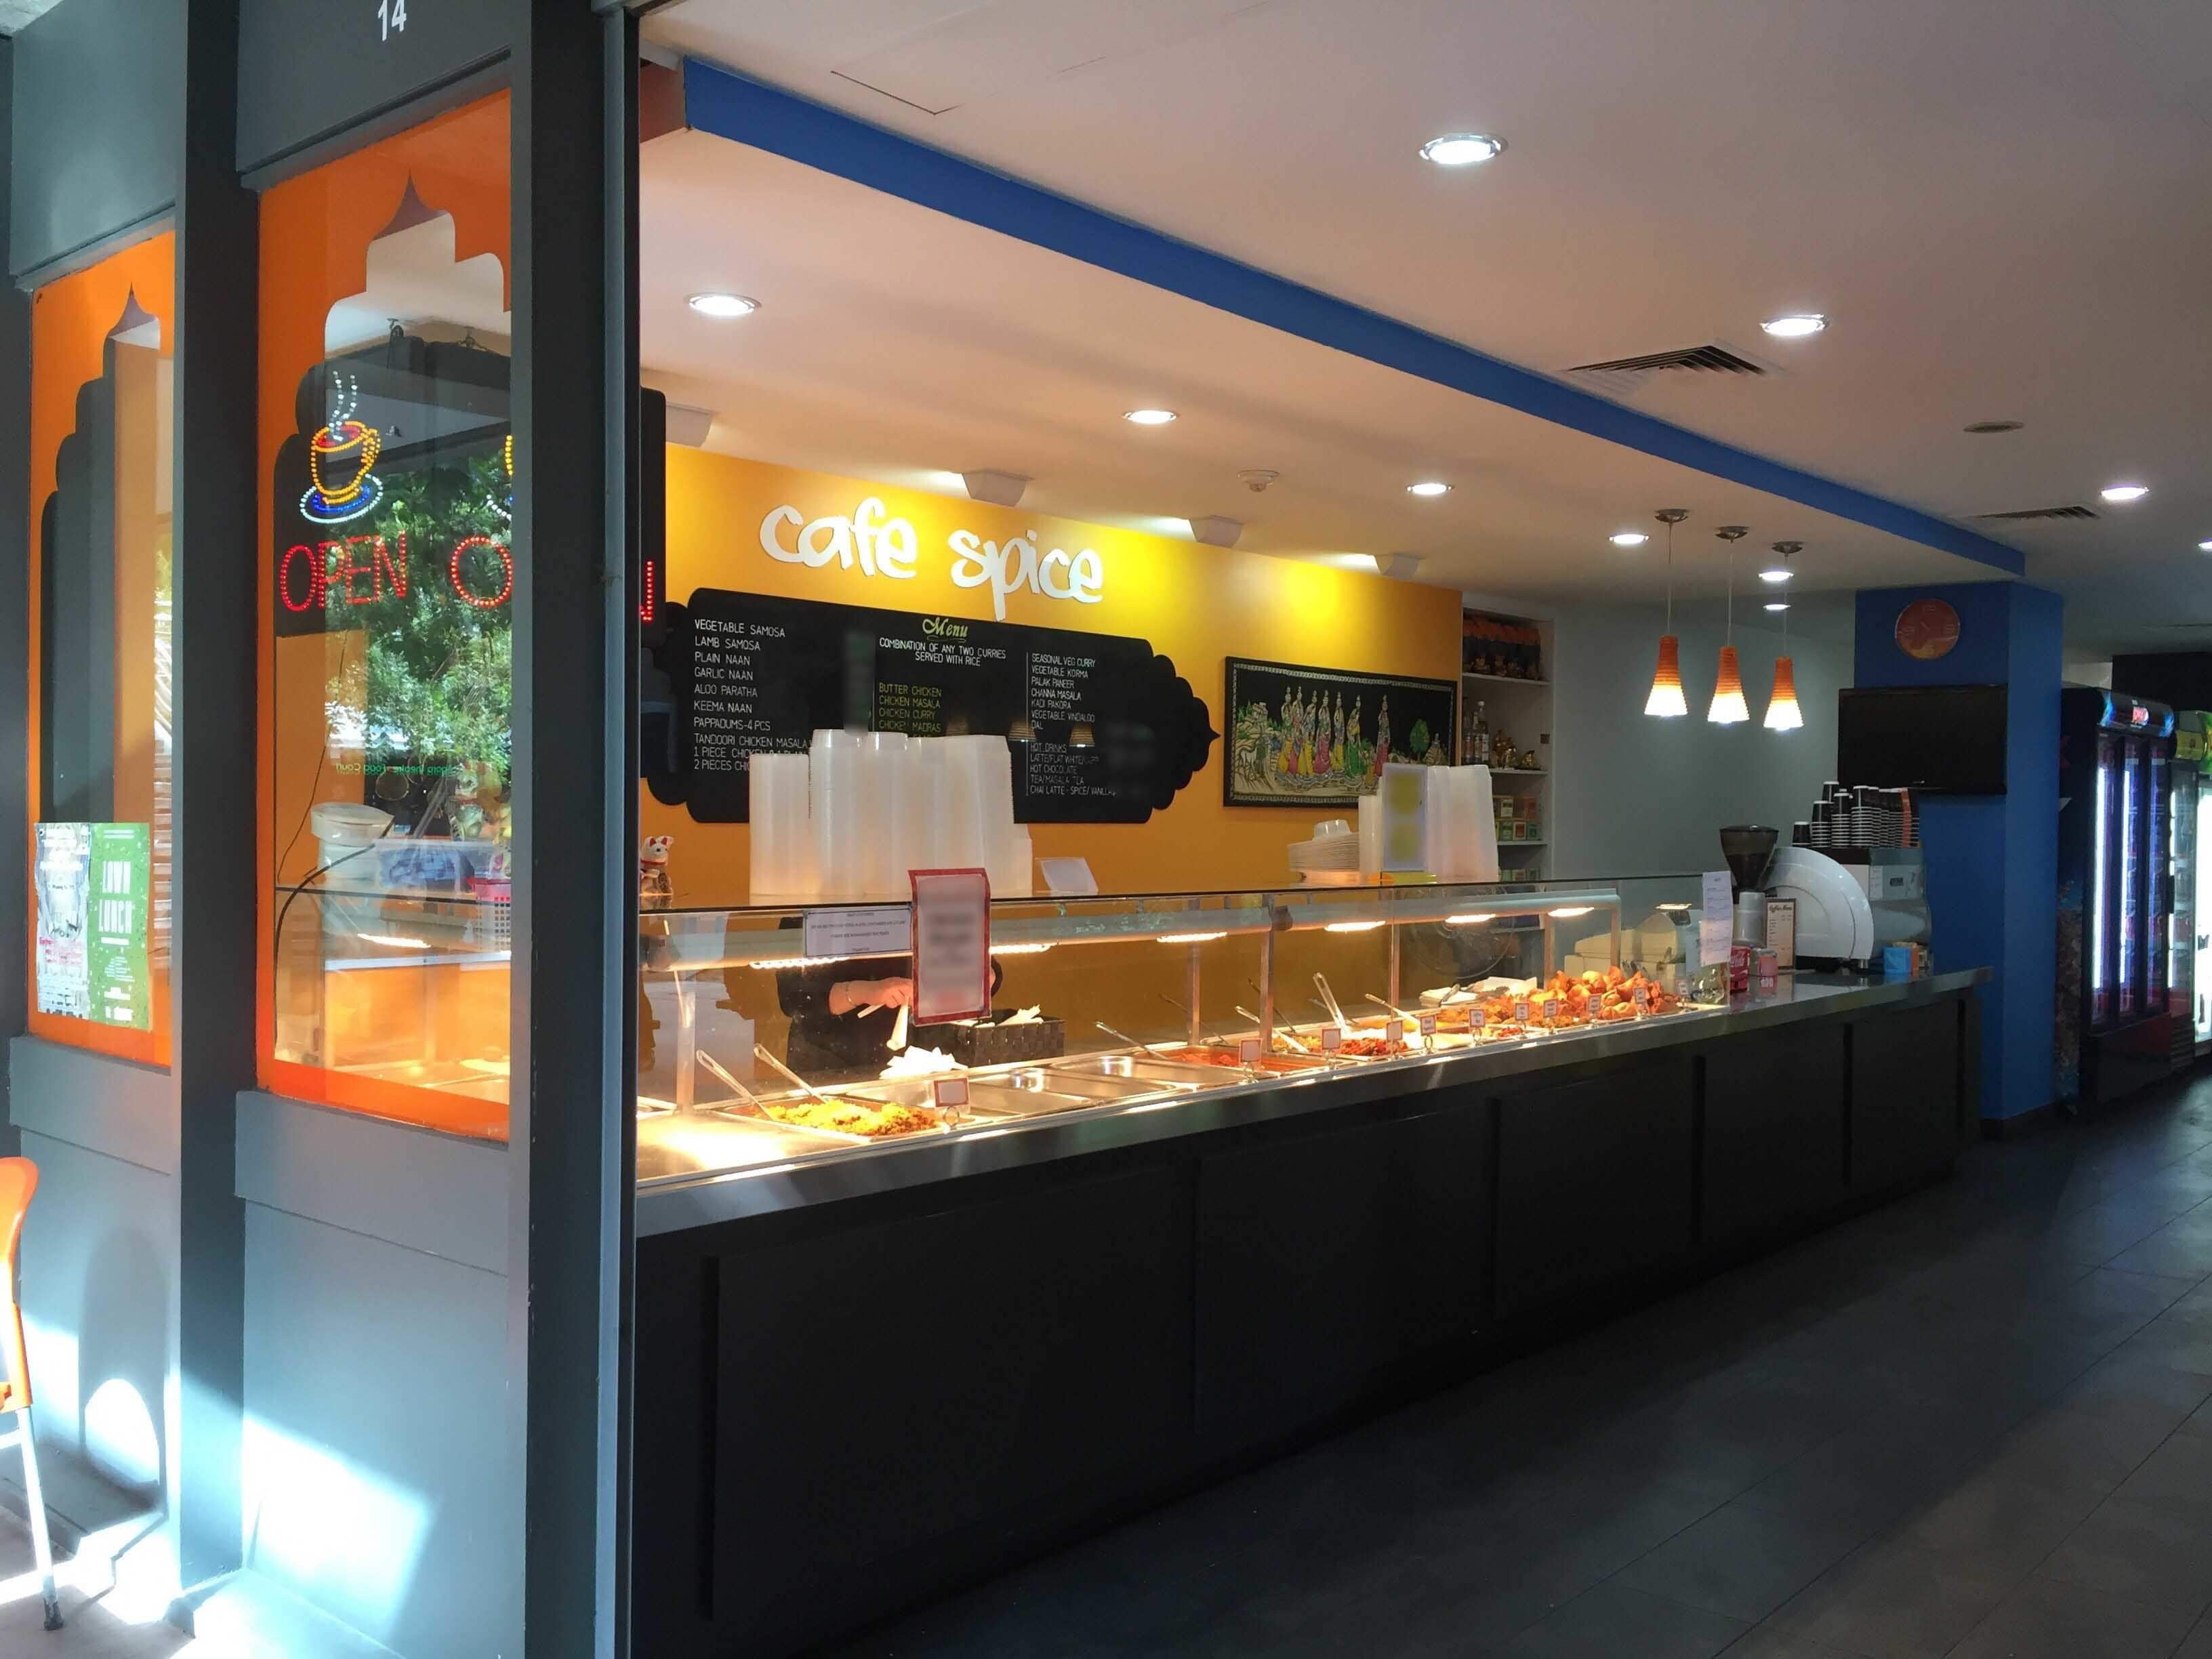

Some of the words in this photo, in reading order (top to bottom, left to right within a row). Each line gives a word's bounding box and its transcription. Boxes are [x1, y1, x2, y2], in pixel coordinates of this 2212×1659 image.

[377, 0, 407, 41] 14
[760, 497, 917, 579] cafe
[947, 530, 1103, 621] spice
[279, 530, 407, 611] OPEN
[695, 619, 745, 634] VEGETABLE
[750, 625, 785, 638] SAMOSA
[922, 617, 968, 637] Menu
[695, 636, 720, 648] LAMB
[725, 638, 760, 651] SAMOSA
[880, 637, 926, 651] COMBINATION
[929, 642, 939, 653] OF
[941, 644, 956, 654] ANY
[959, 645, 974, 656] TWO
[978, 648, 1006, 659] CURRIES
[695, 651, 720, 663] PLAIN
[726, 654, 750, 665] NAAN
[915, 651, 943, 663] SERVED
[946, 655, 963, 665] WITH
[966, 656, 981, 666] RICE
[1031, 653, 1063, 665] SEASONAL
[1063, 656, 1076, 666] VEG
[1077, 658, 1095, 668] CURRY
[695, 667, 724, 678] GARLIC
[729, 670, 754, 680] NAAN
[1031, 665, 1065, 676] VEGETABLE
[1067, 668, 1088, 678] KORMA
[1031, 676, 1050, 687] PALAK
[1052, 678, 1074, 689] PANEER
[695, 684, 717, 695] ALOO
[721, 685, 758, 697] PARATHA
[879, 682, 908, 694] BUTTER
[912, 686, 941, 697] CHICKEN
[1031, 688, 1056, 698] CHANNA
[1057, 690, 1082, 701] MASALA
[694, 701, 724, 712] KEEMA
[728, 702, 752, 714] NAAN
[879, 695, 909, 706] CHICKEN
[913, 698, 941, 709] MASALA
[1048, 700, 1071, 710] PAKORA
[879, 708, 910, 718] CHICKEN
[913, 710, 935, 720] CURRY
[1031, 710, 1065, 720] VEGETABLE
[754, 720, 771, 731] PCS
[912, 722, 941, 733] MADRAS
[1031, 720, 1044, 730] DAL
[694, 733, 735, 745] TANDOORI
[739, 736, 773, 747] CHICKEN
[777, 738, 808, 749] MASALA
[694, 747, 699, 757] 1
[702, 747, 726, 758] PIECE
[1030, 743, 1042, 752] HOT
[1045, 743, 1067, 753] DRINKS
[694, 760, 699, 770] 2
[702, 760, 732, 771] PIECES
[1030, 764, 1042, 773] HOT
[1044, 764, 1077, 775] CHOCOLATE
[1046, 786, 1065, 795] LATTE
[98, 899, 132, 934] LUNCH
